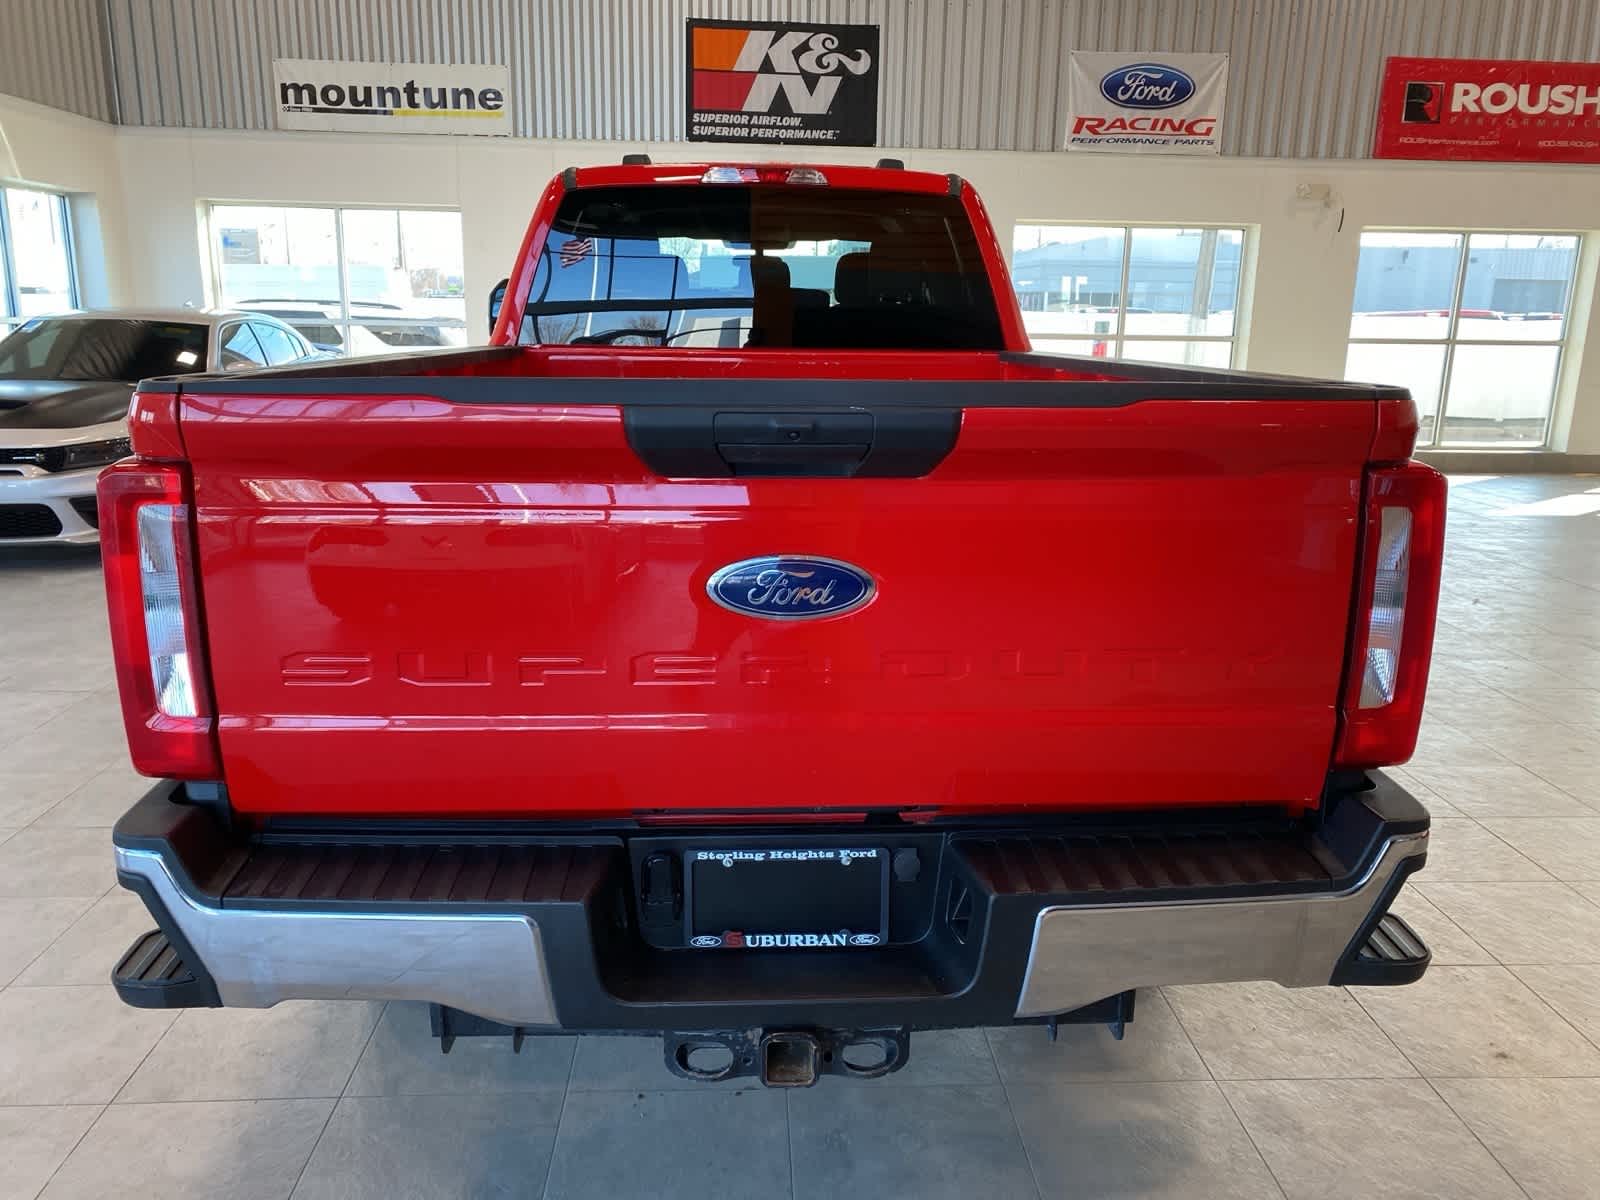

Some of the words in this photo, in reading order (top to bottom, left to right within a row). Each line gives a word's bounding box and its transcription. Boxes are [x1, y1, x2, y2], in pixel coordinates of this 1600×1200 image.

[280, 79, 504, 110] mountune
[1117, 71, 1178, 102] Ford
[1451, 82, 1600, 116] ROUSH
[692, 113, 749, 125] SUPERIOR
[750, 115, 804, 127] AIRFLOW.
[1072, 116, 1217, 137] RACING
[692, 125, 749, 137] SUPERIOR
[1071, 137, 1170, 145] PERFORMANCE
[1174, 138, 1216, 146] PARTS
[747, 569, 837, 606] Ford
[280, 651, 830, 687] SUPER
[697, 851, 766, 861] Sterling
[769, 850, 834, 861] Heights
[838, 849, 877, 858] Ford
[725, 931, 847, 947] SUBURBAN
